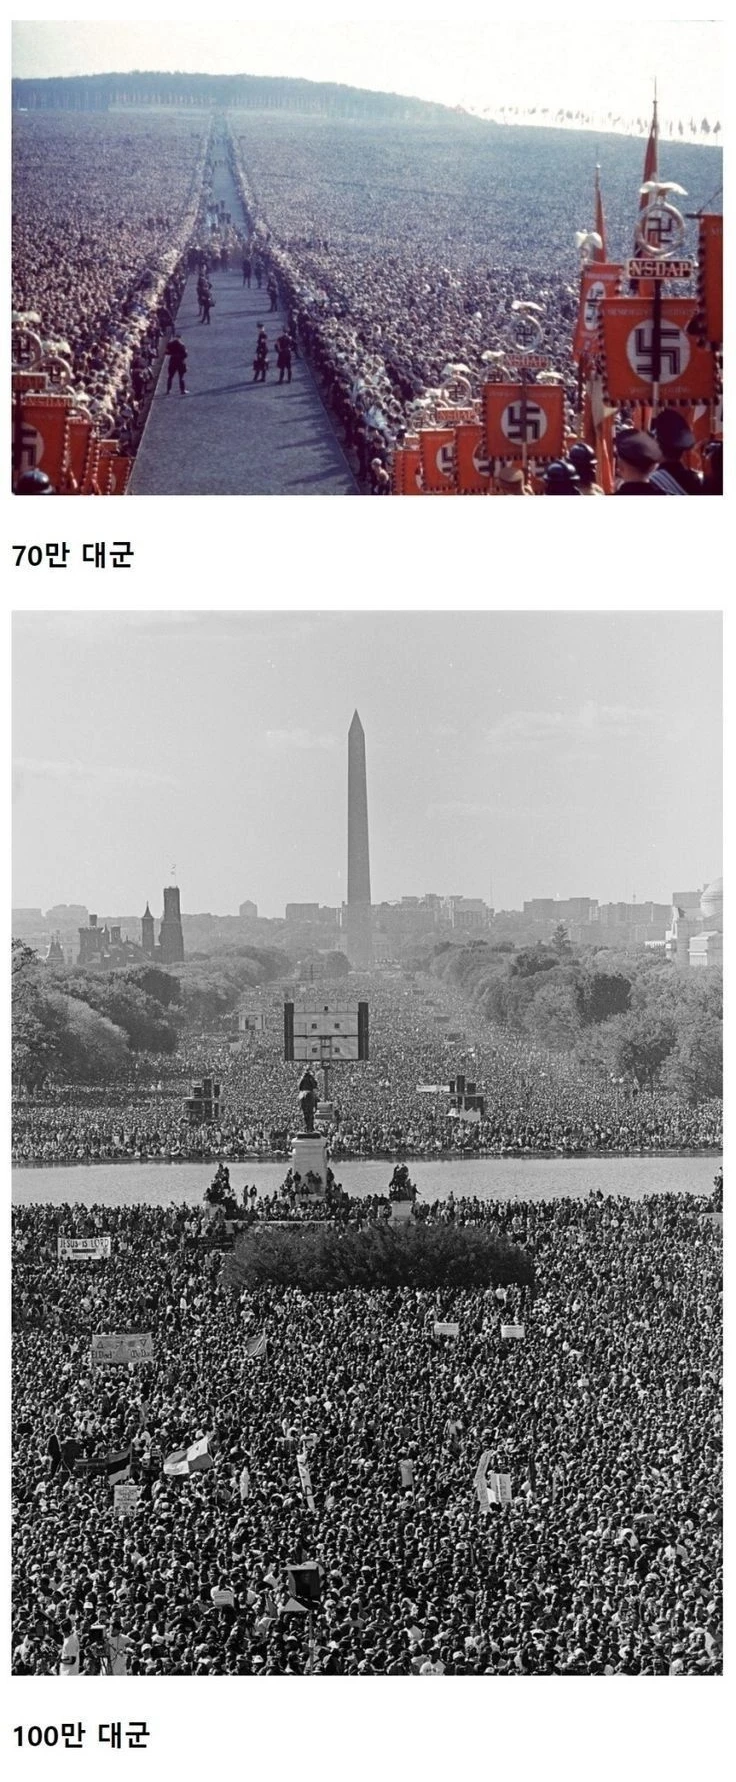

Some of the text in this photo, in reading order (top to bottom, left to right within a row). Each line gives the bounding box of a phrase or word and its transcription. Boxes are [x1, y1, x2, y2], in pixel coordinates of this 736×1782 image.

[630, 261, 690, 277] NSDAP
[60, 1239, 78, 1248] JESUS
[90, 1238, 109, 1248] LORD
